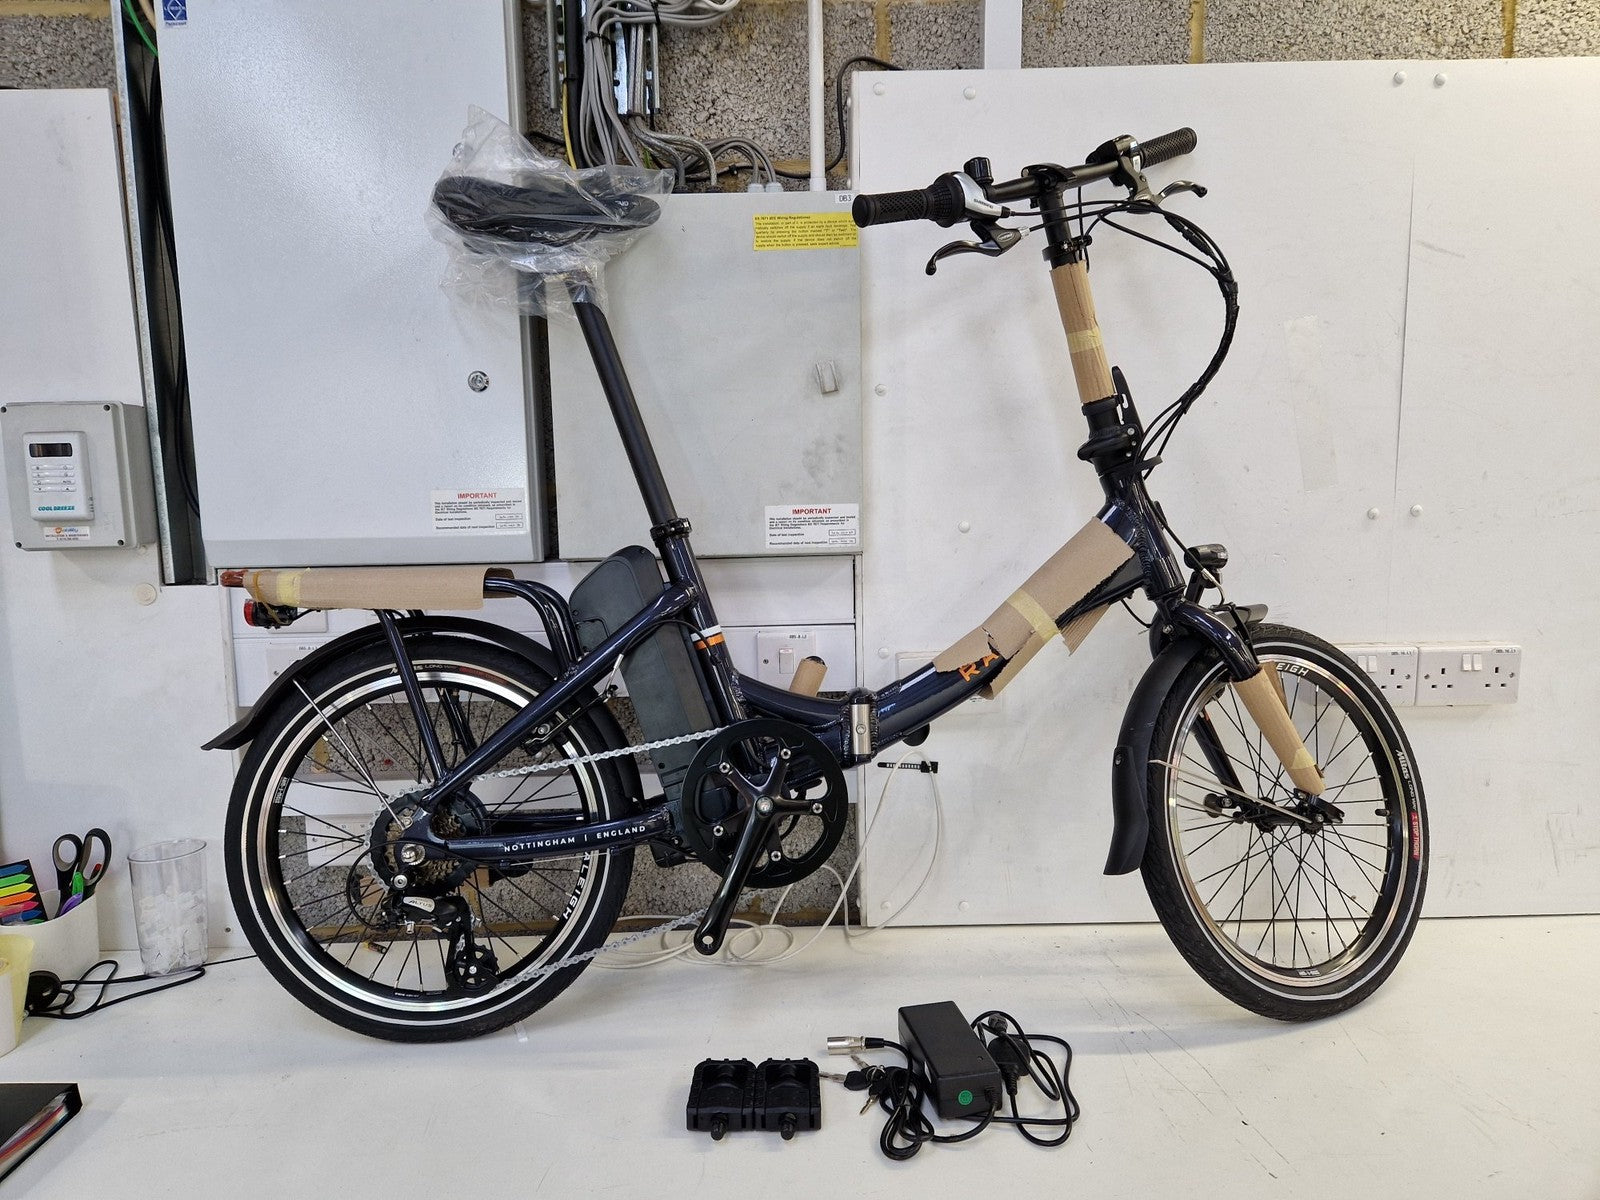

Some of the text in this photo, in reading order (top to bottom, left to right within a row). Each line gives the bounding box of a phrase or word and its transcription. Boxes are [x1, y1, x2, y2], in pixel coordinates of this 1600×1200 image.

[1275, 662, 1310, 677] EIGH
[504, 836, 576, 852] NOTTINGHAM
[596, 825, 646, 839] ENGLAND
[562, 851, 591, 920] ALEIGH
